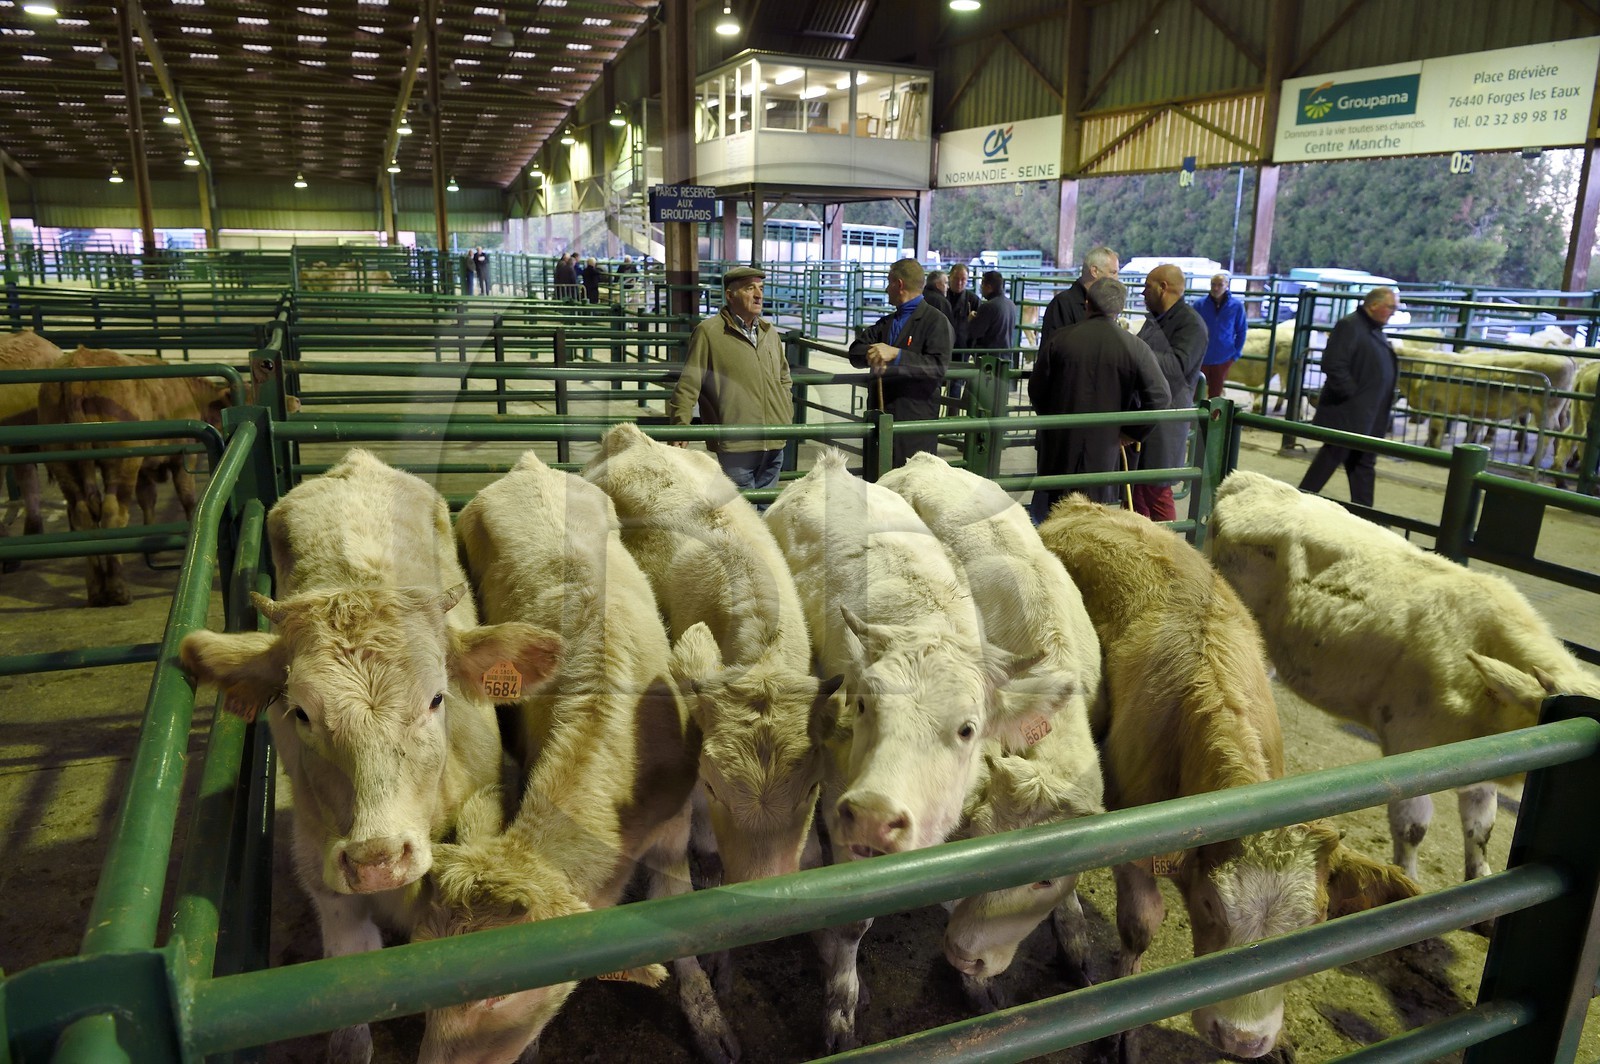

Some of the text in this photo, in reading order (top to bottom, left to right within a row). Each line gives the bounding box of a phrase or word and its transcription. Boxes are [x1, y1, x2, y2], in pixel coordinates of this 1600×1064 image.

[1473, 65, 1559, 84] Place Brévière
[1337, 92, 1409, 110] Groupama
[1449, 85, 1581, 108] 76440 Forges les Eaux
[1453, 108, 1568, 128] Tél. 02 32 89 98 18
[1284, 130, 1317, 140] Donnons
[1319, 127, 1325, 136] à
[1326, 126, 1333, 136] la
[1335, 126, 1346, 135] vie
[1348, 124, 1374, 134] toutes
[1375, 123, 1387, 132] ses
[1304, 135, 1401, 154] Centre Manche
[945, 168, 1007, 184] NORMANDIE
[1018, 163, 1055, 178] SEINE
[655, 185, 716, 199] PARCS RESERVES
[676, 199, 694, 208] AUX
[660, 208, 712, 220] BROUTARDS
[484, 680, 518, 698] 5684
[1025, 720, 1051, 745] 5672
